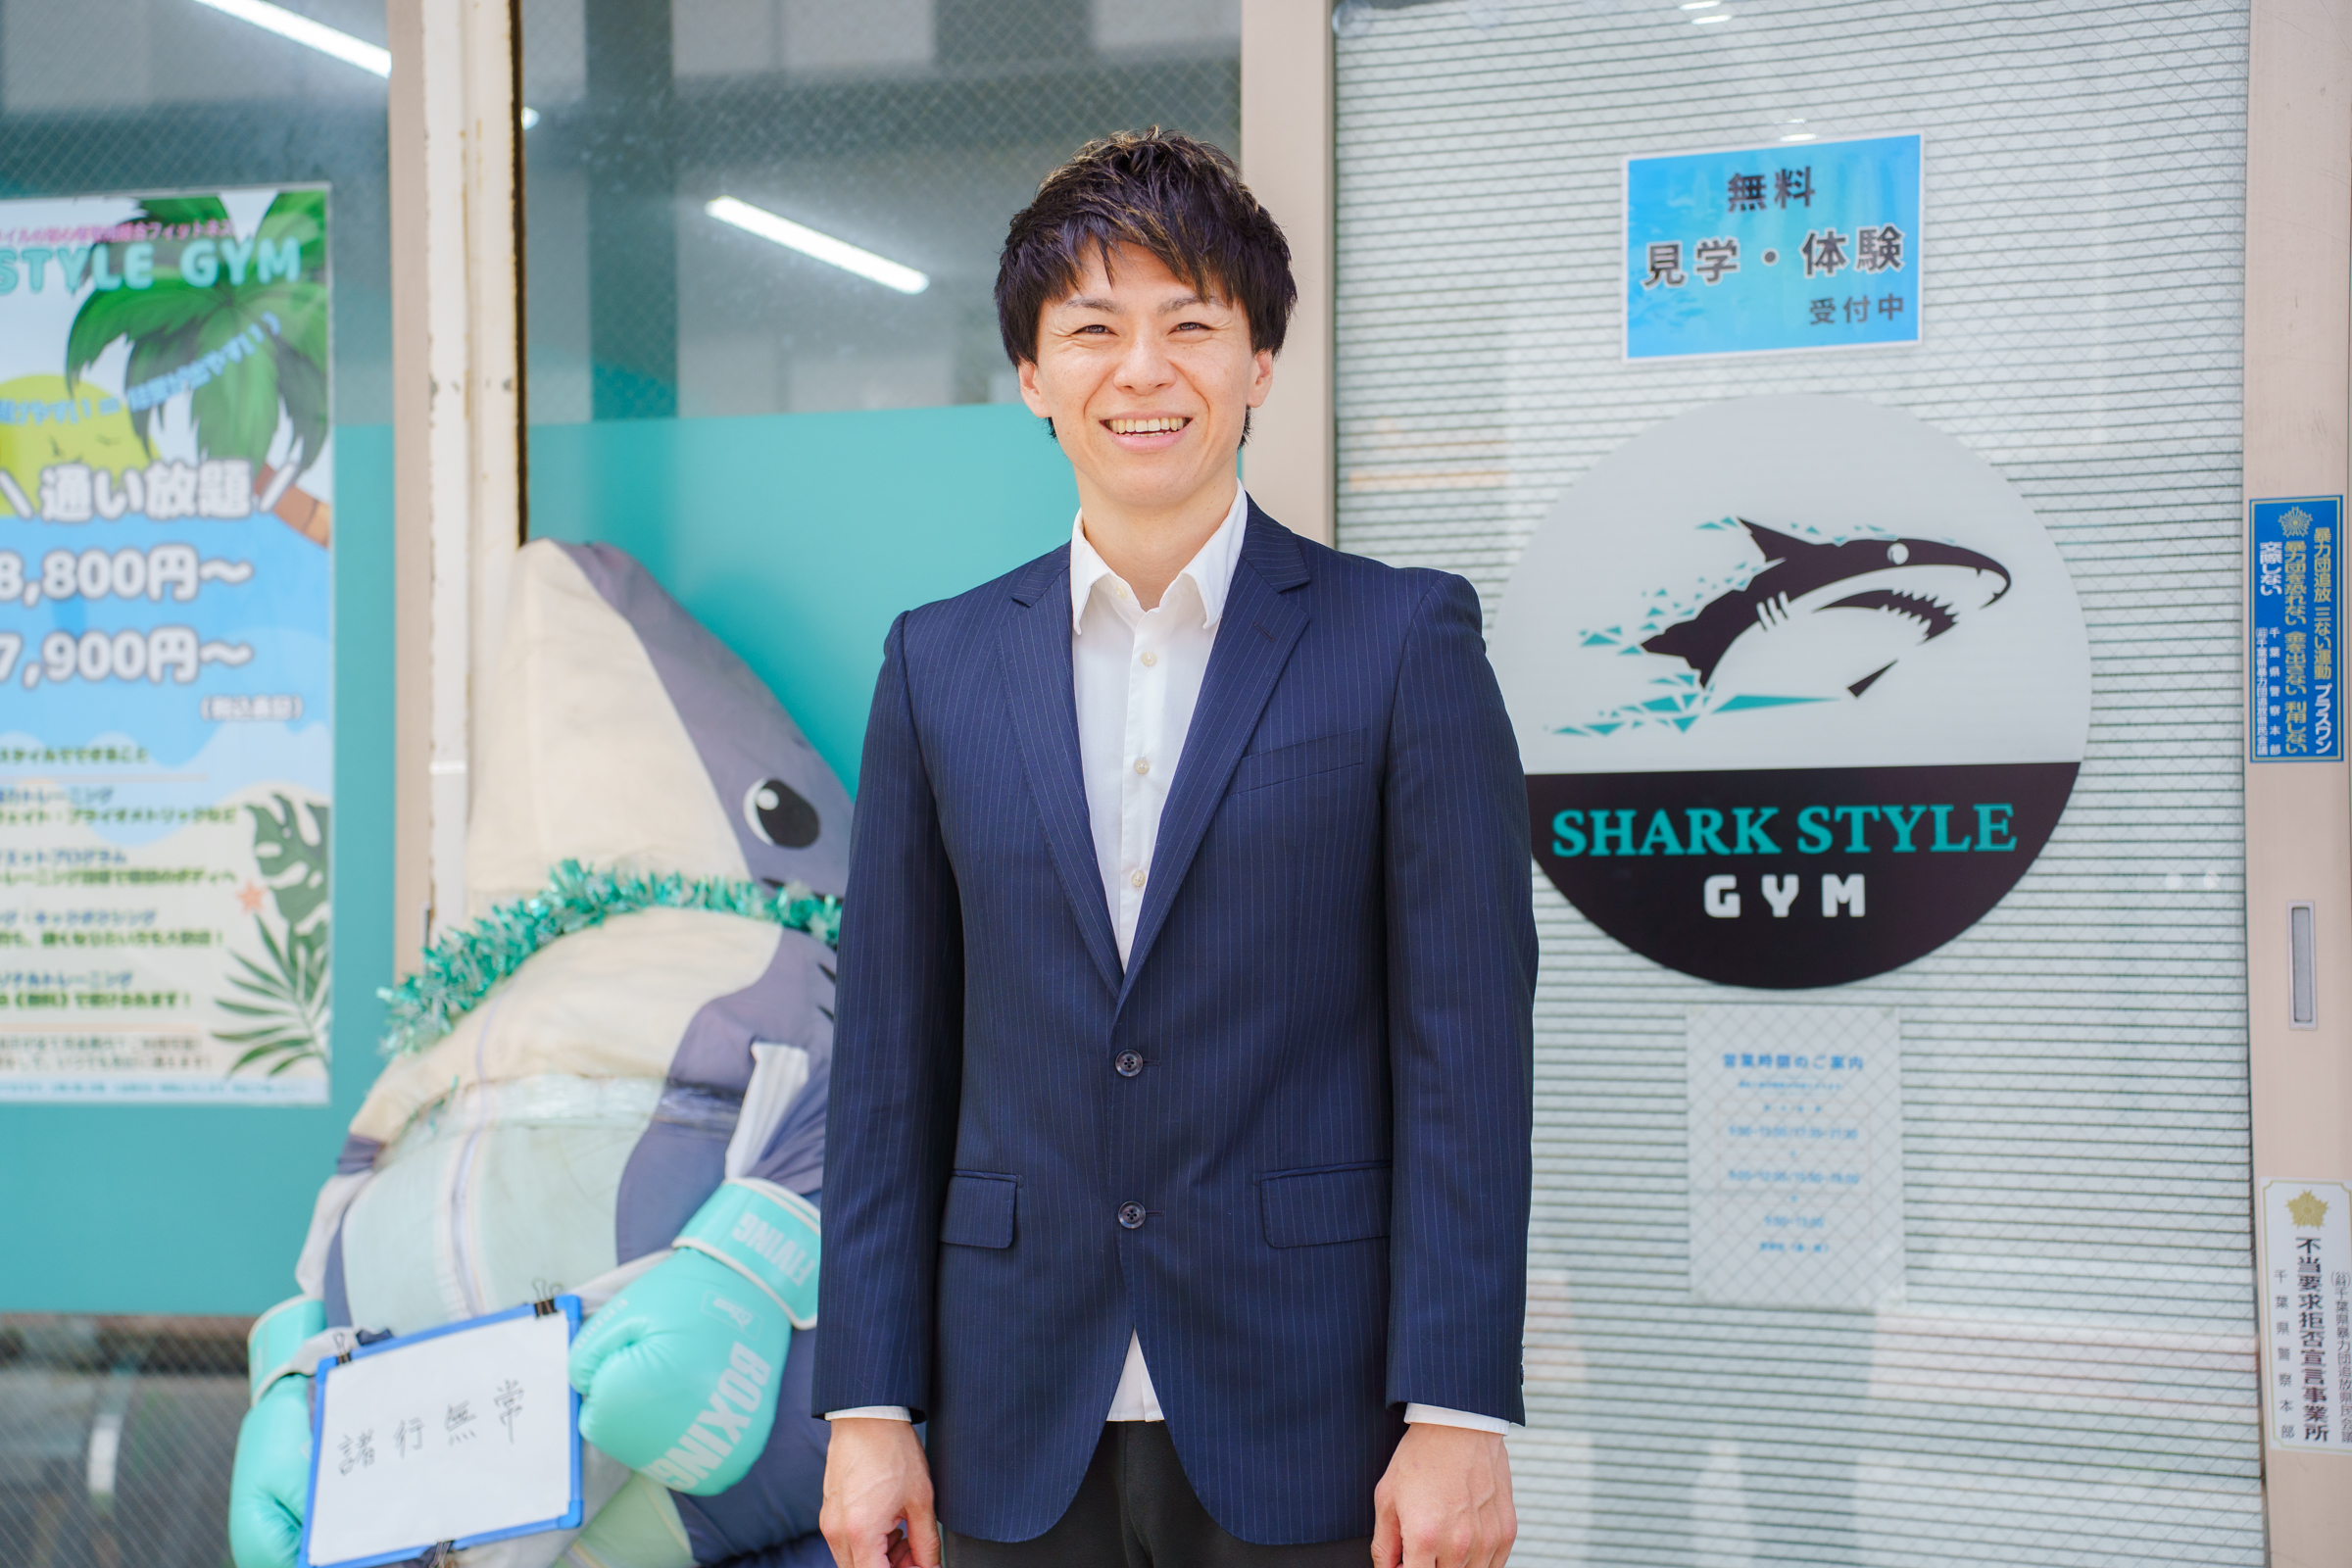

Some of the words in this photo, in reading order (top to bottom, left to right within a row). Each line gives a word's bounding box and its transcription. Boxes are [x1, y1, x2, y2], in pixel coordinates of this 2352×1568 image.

[1727, 166, 1816, 213] 無料
[179, 236, 302, 288] GYM
[1642, 223, 1905, 289] 見学・体験
[1810, 293, 1904, 325] 受付中
[39, 459, 253, 523] 通い放題
[2259, 541, 2282, 597] 交際しない
[2284, 540, 2307, 625] 暴力団を恐れない
[2313, 526, 2331, 603] 暴力団追放
[2284, 630, 2307, 696] 金を出さない
[2313, 606, 2331, 680] 三ない運動
[2269, 626, 2281, 756] 千葉県警察本部
[2314, 682, 2332, 755] プラスワン
[2284, 701, 2307, 755] 利用しない
[1552, 808, 1782, 858] SHARK
[1796, 804, 2018, 854] STYLE
[1703, 873, 1866, 918] GYM
[1723, 1054, 1864, 1071] 営業時間のご案内
[2274, 1269, 2295, 1440] 千葉県警察本部
[2295, 1236, 2329, 1443] 不当要求拒否宣言事業所
[337, 1378, 526, 1477] 諸行無常
